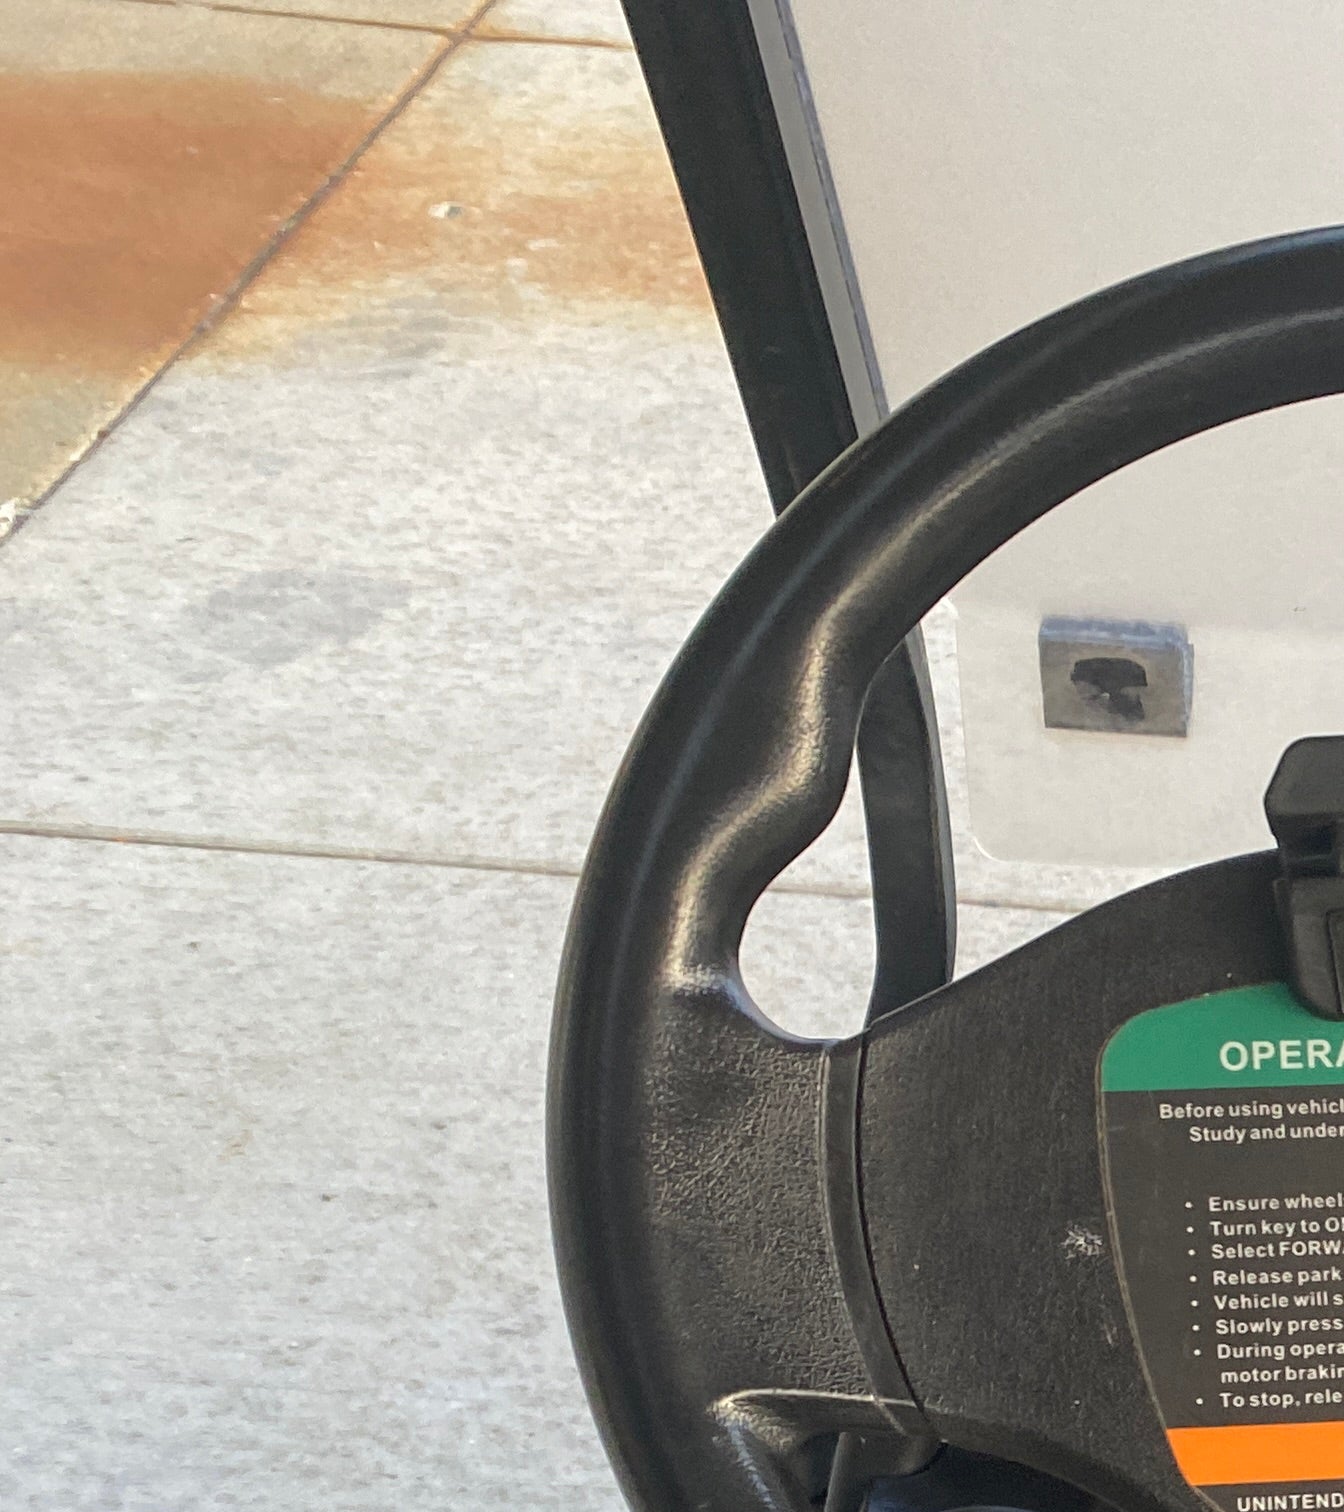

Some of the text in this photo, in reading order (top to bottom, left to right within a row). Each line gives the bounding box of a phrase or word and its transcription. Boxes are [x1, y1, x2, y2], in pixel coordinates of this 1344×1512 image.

[1160, 1103, 1224, 1119] Before
[1229, 1101, 1283, 1119] using
[1190, 1125, 1246, 1144] Study
[1250, 1124, 1286, 1140] and
[1209, 1197, 1279, 1212] Ensure
[1209, 1221, 1256, 1236] Turn
[1261, 1220, 1296, 1237] key
[1300, 1220, 1320, 1233] to
[1212, 1243, 1275, 1259] Select
[1213, 1270, 1293, 1285] Release
[1298, 1266, 1342, 1286] park
[1214, 1293, 1288, 1310] Vehicle
[1294, 1291, 1328, 1306] will
[1216, 1318, 1282, 1336] Slowly
[1288, 1318, 1343, 1335] press
[1217, 1343, 1285, 1360] During
[1221, 1368, 1281, 1383] motor
[1219, 1393, 1245, 1407] To
[1249, 1393, 1300, 1408] stop,
